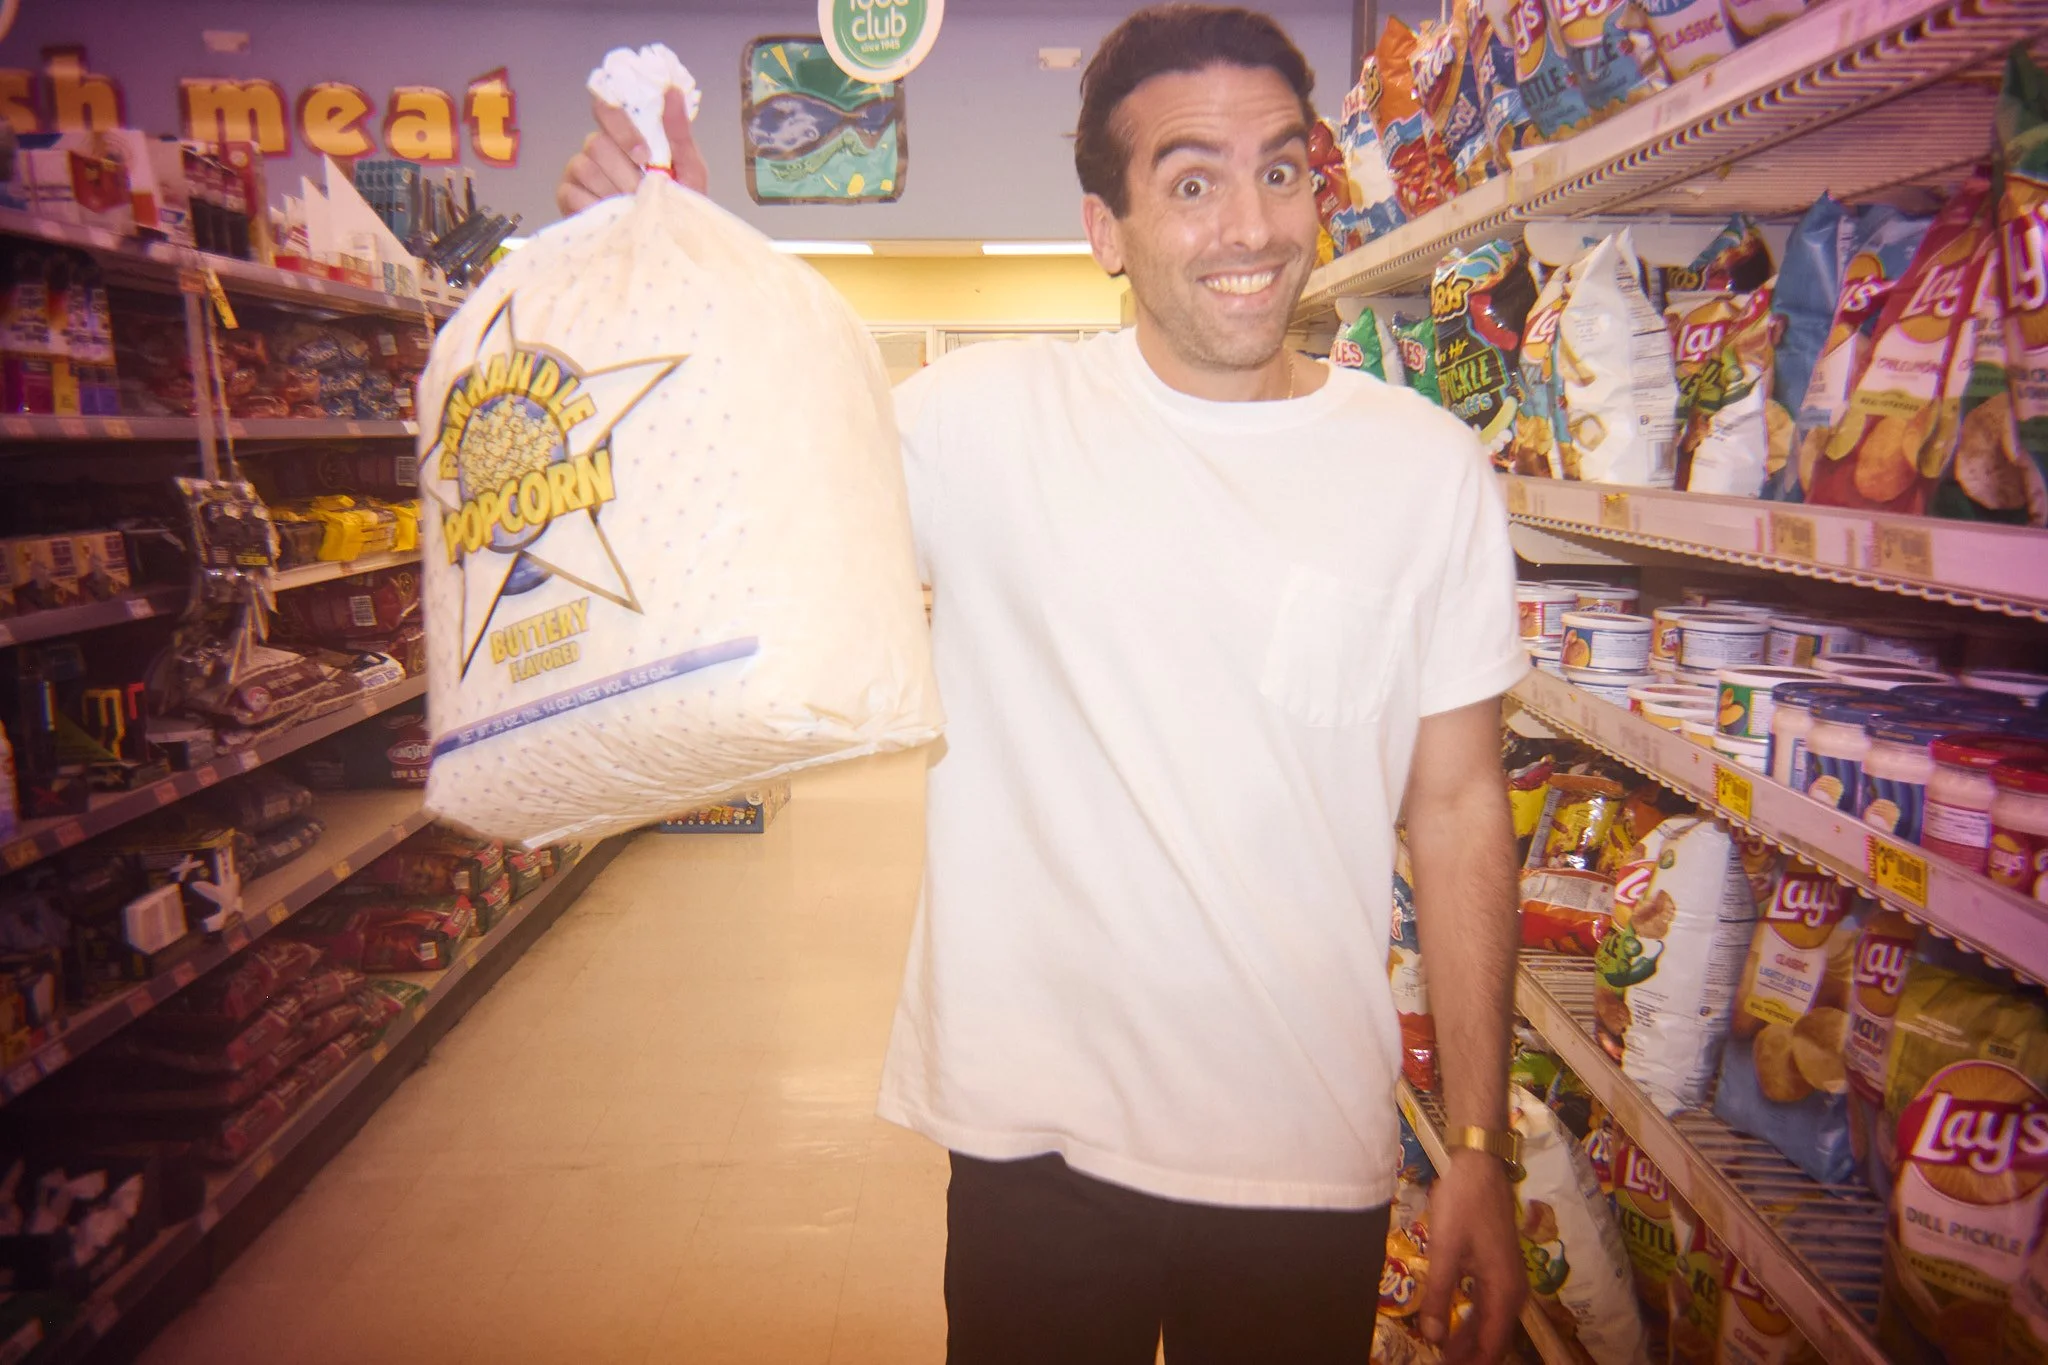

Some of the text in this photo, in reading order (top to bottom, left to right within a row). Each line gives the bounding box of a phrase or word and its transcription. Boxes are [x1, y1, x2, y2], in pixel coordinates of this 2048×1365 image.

[852, 6, 907, 42] club
[180, 68, 520, 167] meat
[439, 351, 598, 481] PANHANDLE
[444, 449, 616, 566] POPCORN
[489, 596, 591, 665] BUTTERY
[508, 640, 581, 684] FLAVORED
[579, 685, 601, 704] NET
[1905, 1206, 2022, 1256] DILL PICKLE
